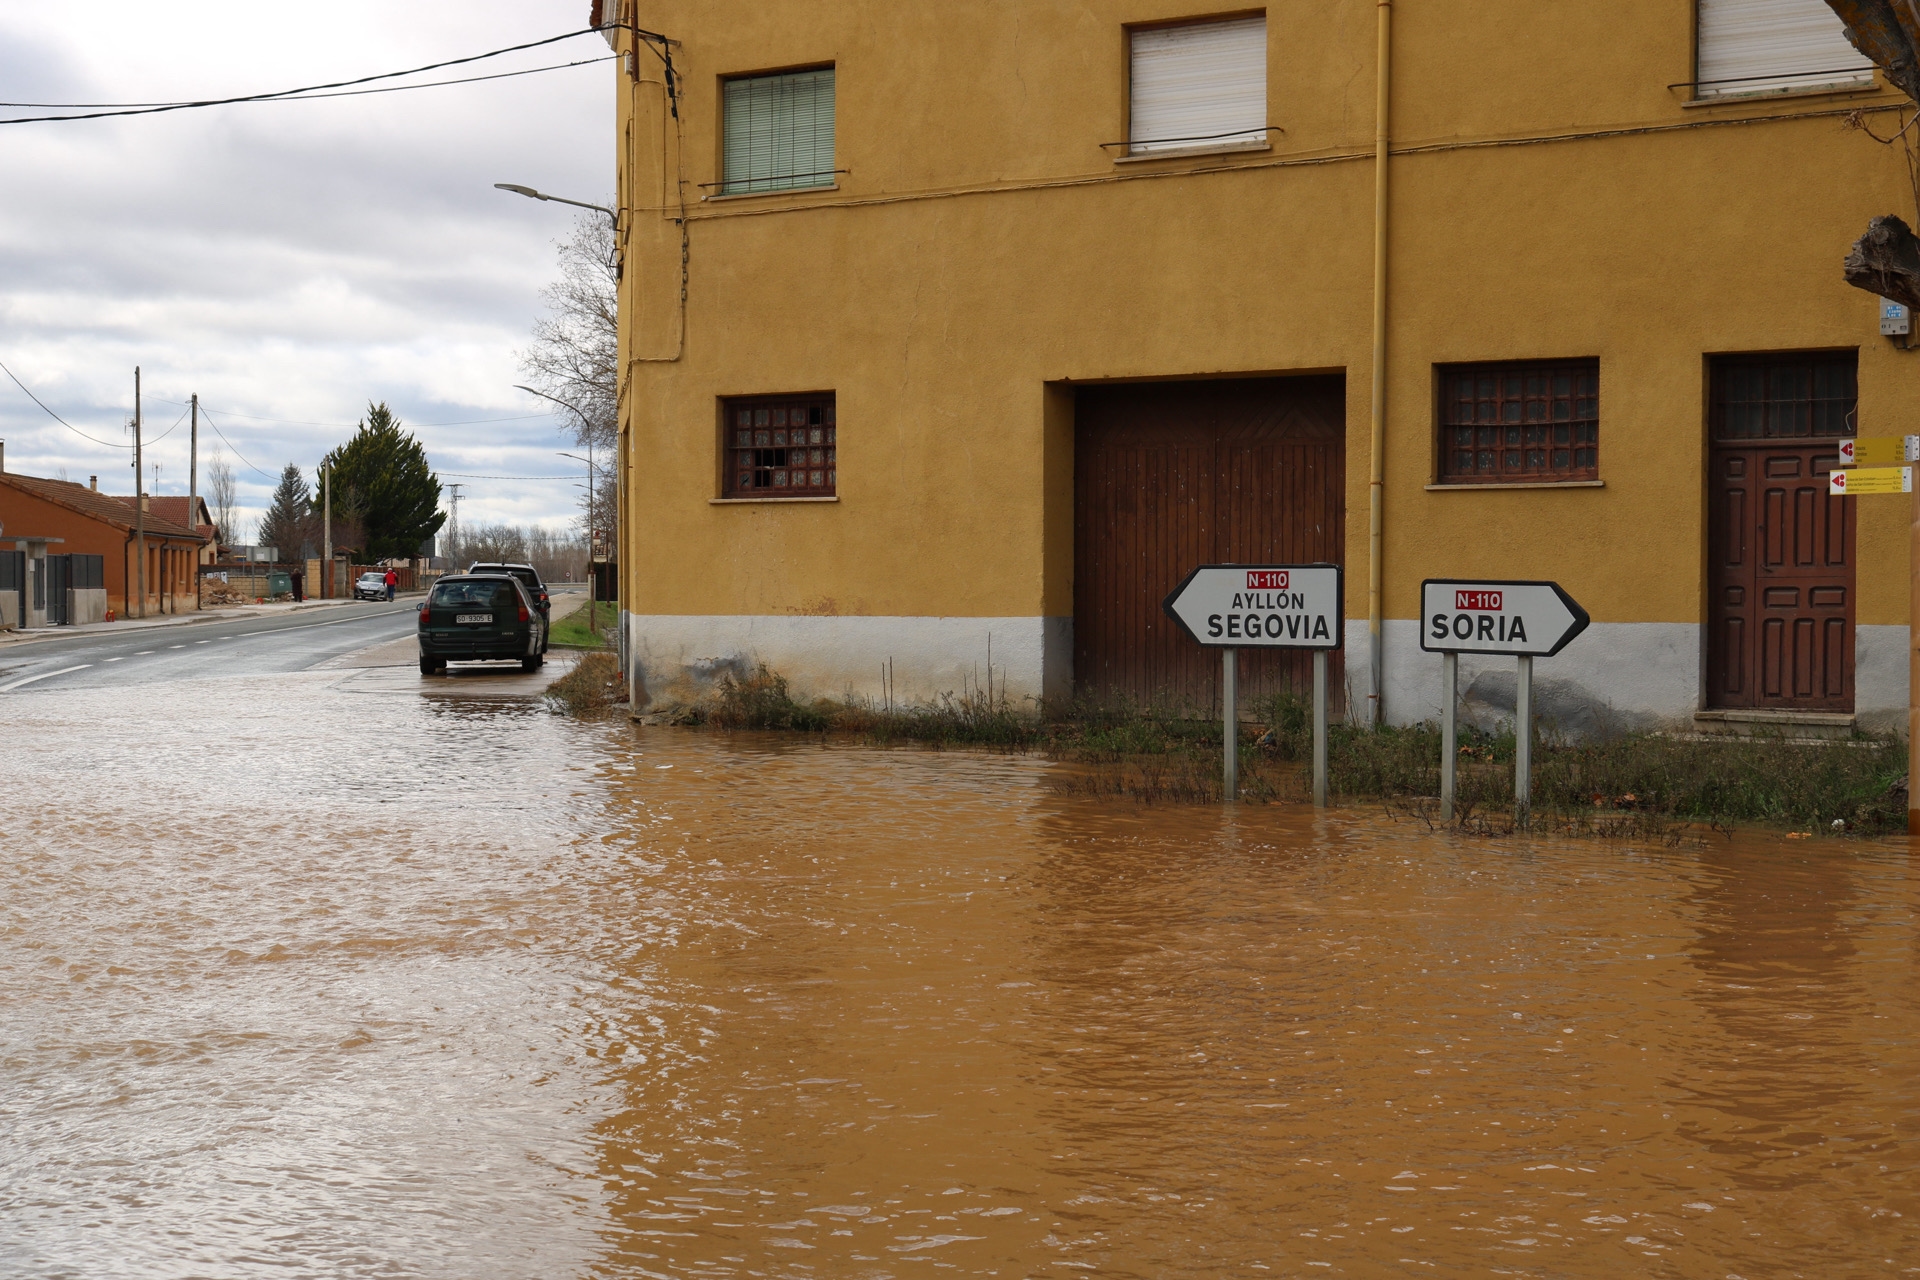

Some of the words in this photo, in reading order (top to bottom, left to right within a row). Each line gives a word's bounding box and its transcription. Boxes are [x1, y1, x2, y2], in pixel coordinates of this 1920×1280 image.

[1248, 573, 1288, 587] N-110
[1231, 589, 1305, 610] AYLLÓN
[1457, 592, 1501, 608] N-110
[1207, 613, 1331, 640] SEGOVIA
[1431, 613, 1528, 643] SORIA
